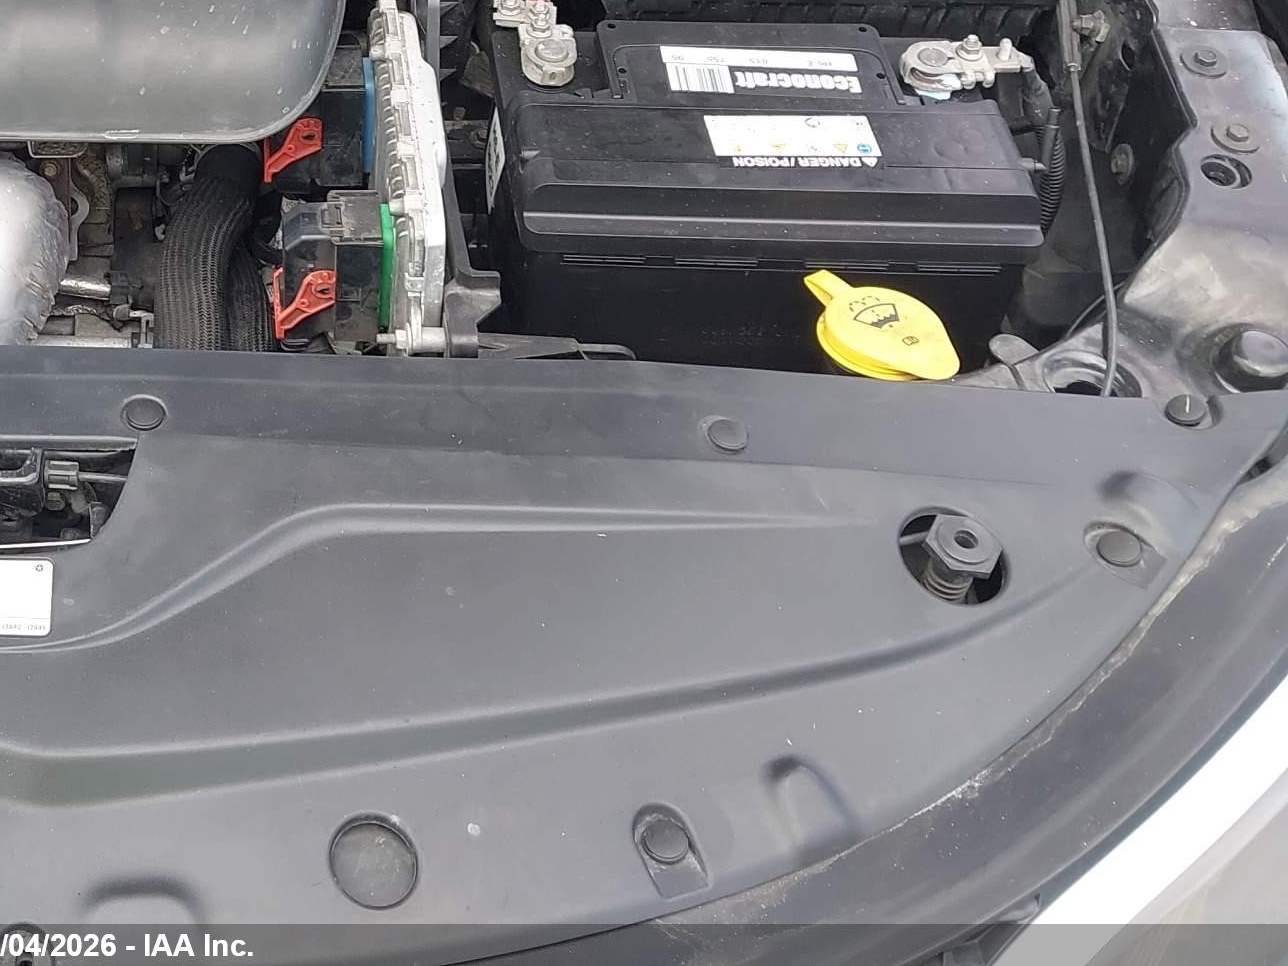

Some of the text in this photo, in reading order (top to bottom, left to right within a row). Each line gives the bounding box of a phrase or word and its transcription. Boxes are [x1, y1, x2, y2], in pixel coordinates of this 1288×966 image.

[733, 70, 863, 94] Econocraft
[732, 156, 789, 167] POISON
[797, 156, 862, 167] DANGER
